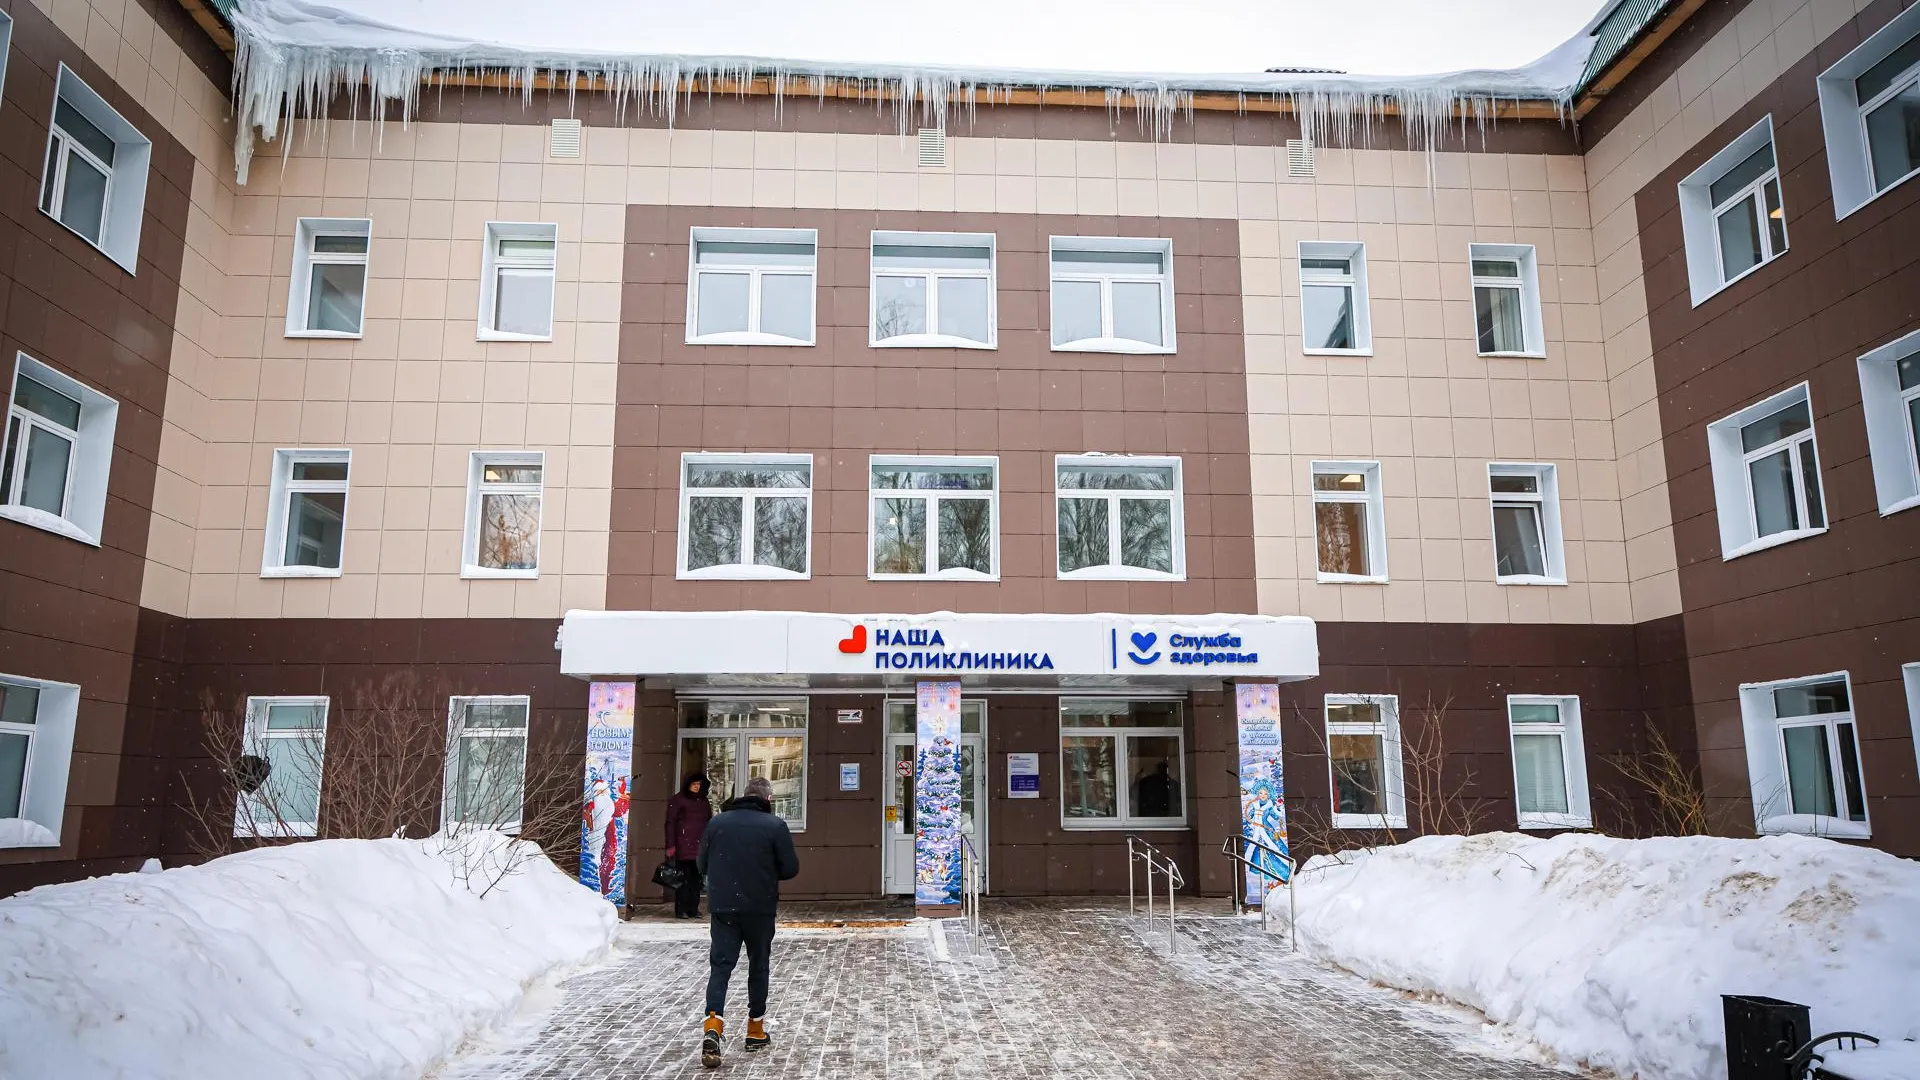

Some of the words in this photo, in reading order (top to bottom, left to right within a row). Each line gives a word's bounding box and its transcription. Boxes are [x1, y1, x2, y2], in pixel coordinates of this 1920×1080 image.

[876, 629, 945, 646] НАША
[1169, 633, 1242, 650] Служба
[876, 652, 1054, 669] ПОЛИКЛИНИКА
[1169, 652, 1258, 666] здоровья
[591, 728, 630, 739] НОВЫМ
